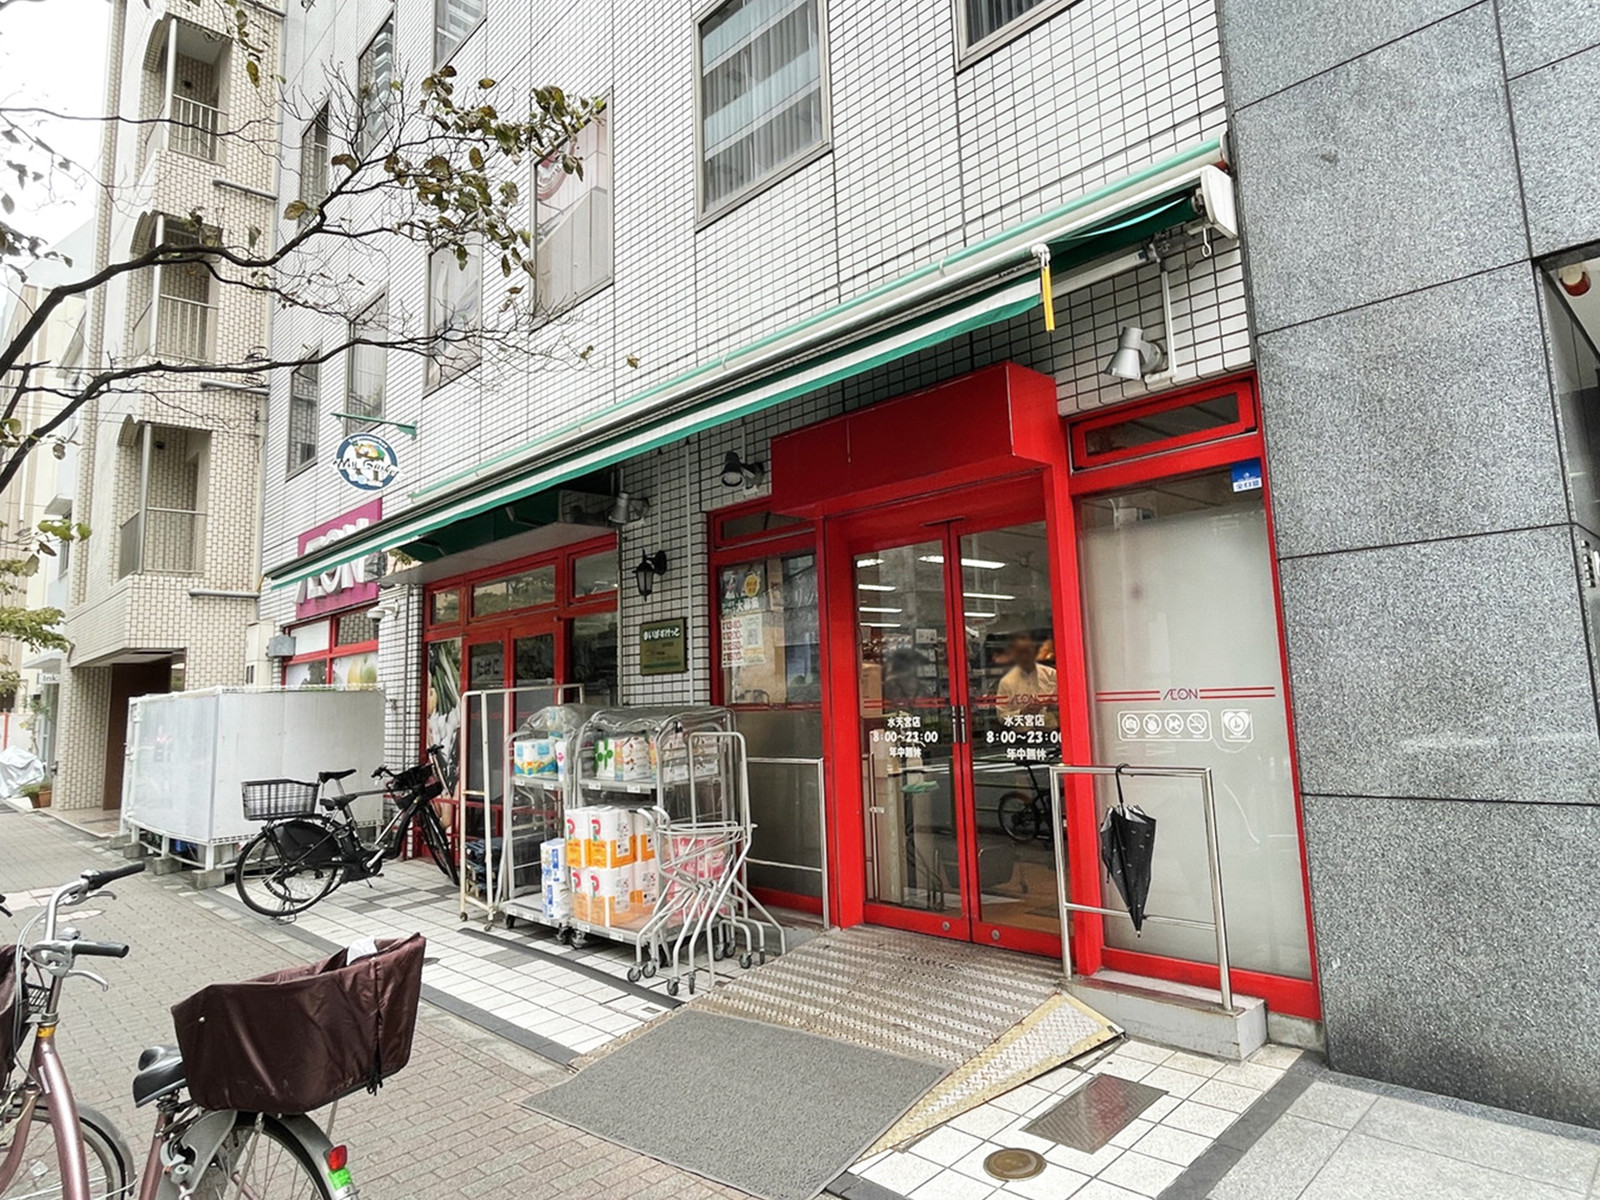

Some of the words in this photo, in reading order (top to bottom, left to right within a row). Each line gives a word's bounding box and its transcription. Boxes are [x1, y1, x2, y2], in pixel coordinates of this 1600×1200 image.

[887, 716, 921, 728] 水天宮店
[1003, 714, 1045, 727] 水天宮店
[1006, 747, 1047, 760] 年中無休
